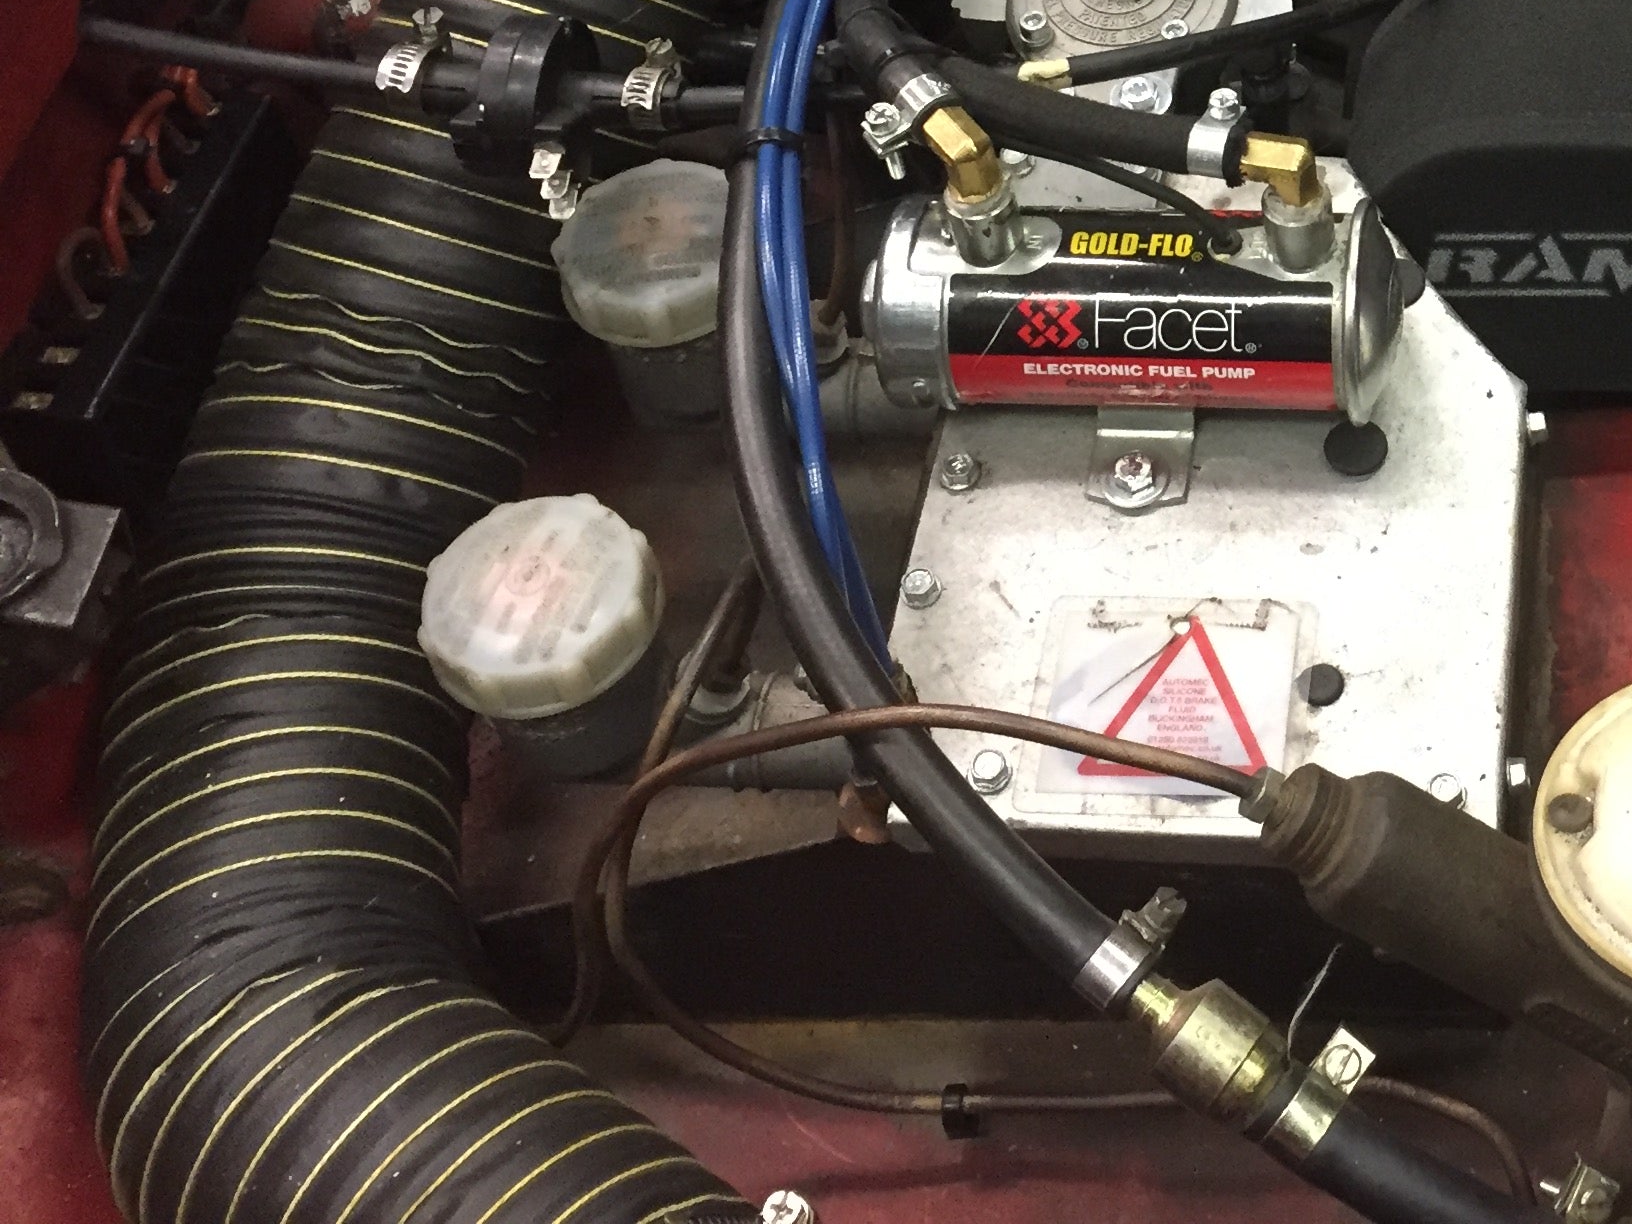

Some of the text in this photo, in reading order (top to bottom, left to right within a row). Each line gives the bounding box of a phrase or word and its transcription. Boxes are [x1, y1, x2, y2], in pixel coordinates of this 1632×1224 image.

[1069, 231, 1194, 258] GOLD-FLO
[1094, 294, 1247, 353] Facet
[1023, 363, 1256, 380] ELECTRONIC FUEL PUMP
[1148, 714, 1214, 723] BUCKINGHAM
